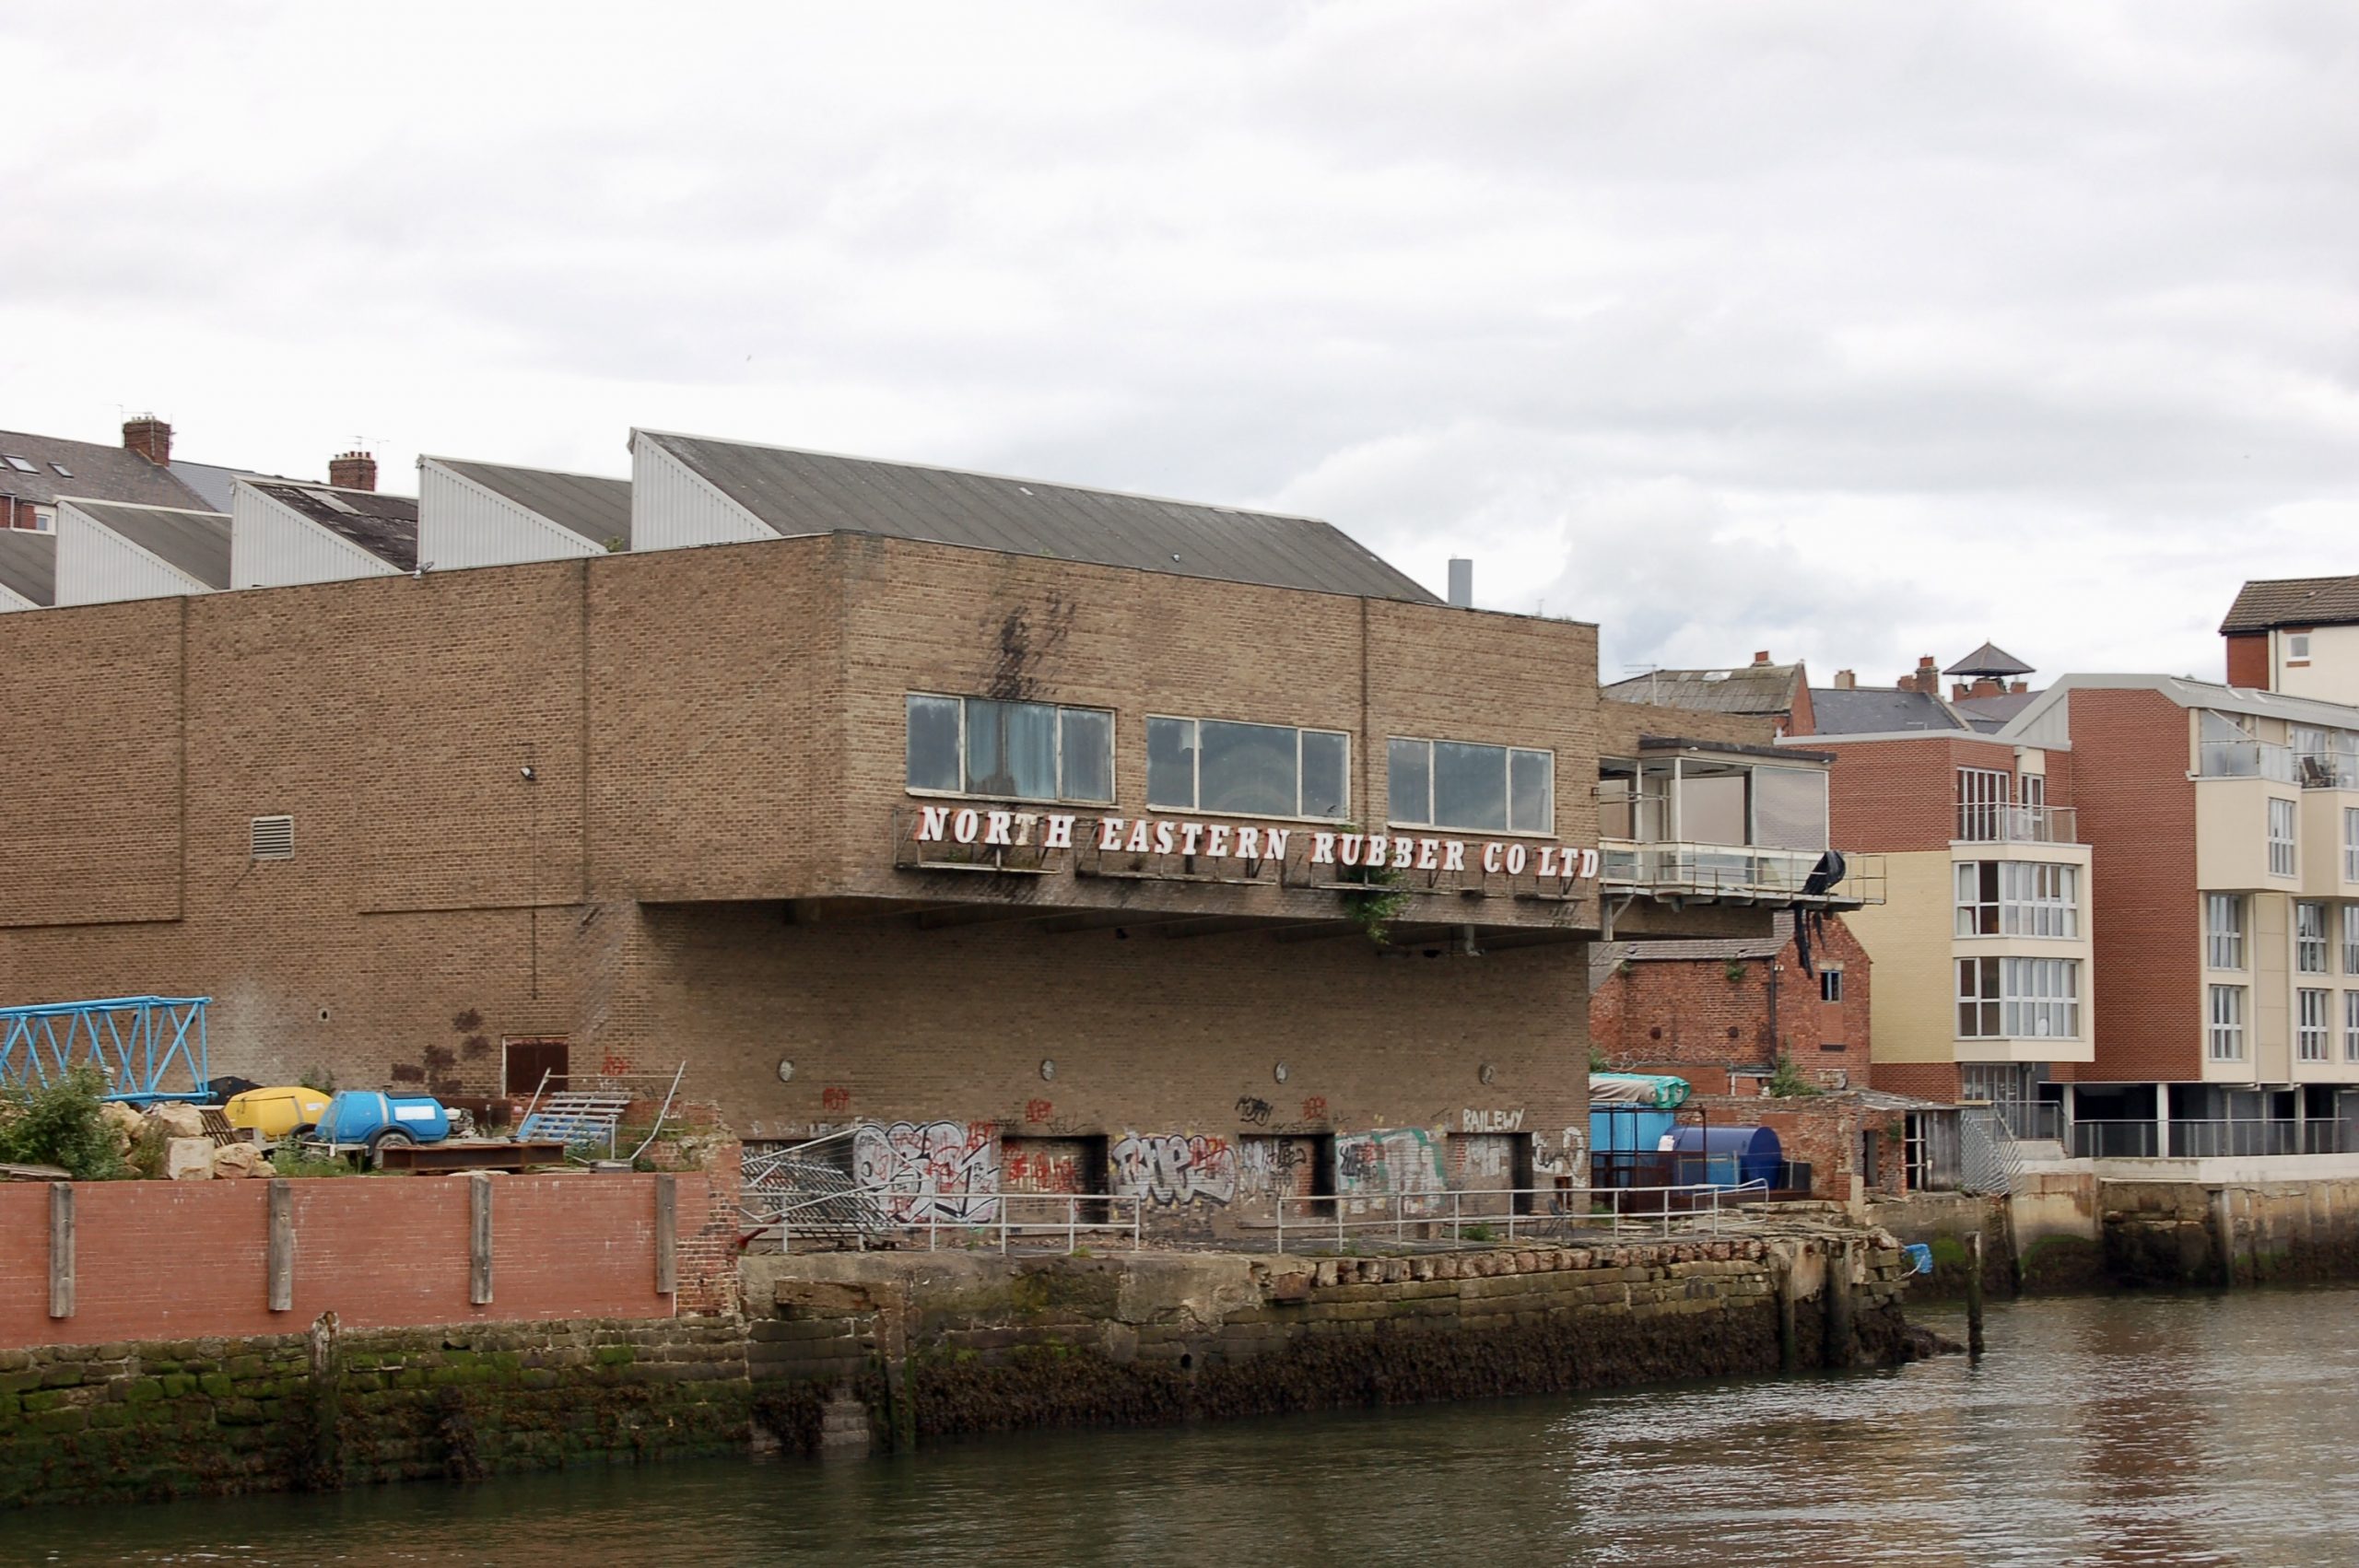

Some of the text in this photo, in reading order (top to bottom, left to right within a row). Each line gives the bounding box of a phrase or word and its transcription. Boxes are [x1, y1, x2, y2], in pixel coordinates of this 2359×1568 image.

[915, 805, 1600, 879] NORTH EASTERN RUBBER CO LTD
